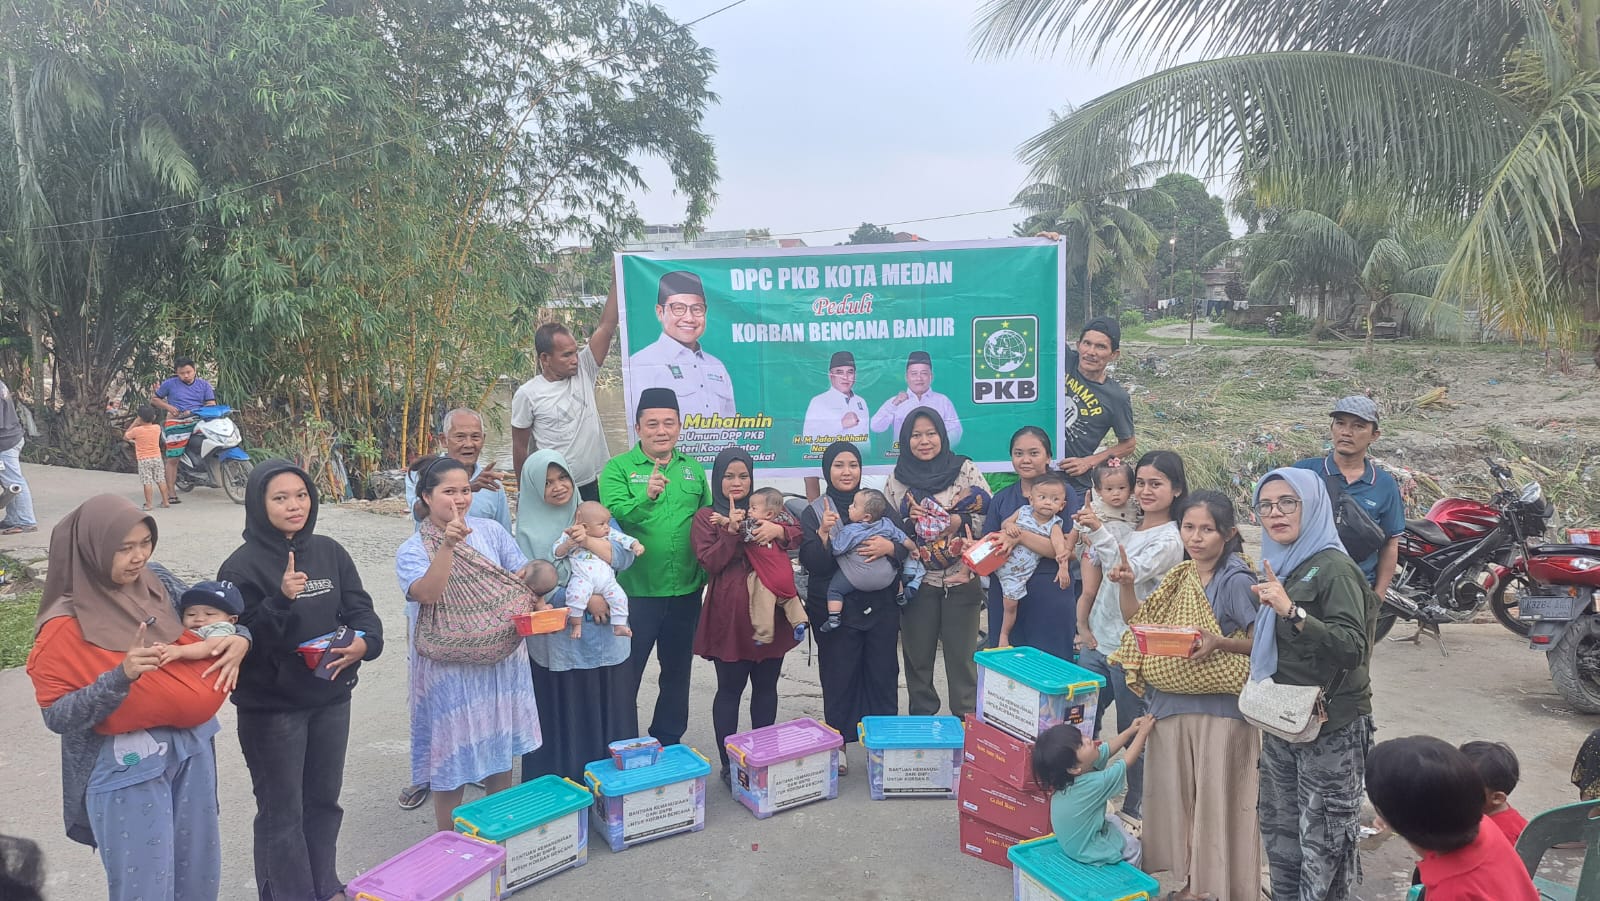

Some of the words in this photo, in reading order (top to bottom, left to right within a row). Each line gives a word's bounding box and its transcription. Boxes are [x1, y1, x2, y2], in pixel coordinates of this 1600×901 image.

[730, 268, 773, 291] DPC
[778, 266, 820, 290] PKB
[825, 264, 877, 288] KOTA
[881, 261, 953, 286] MEDAN
[812, 292, 874, 316] Peduli
[731, 322, 805, 343] KORBAN
[809, 319, 889, 342] BENCANA
[893, 317, 955, 339] BANJIR
[975, 381, 1036, 401] PKB
[684, 413, 773, 430] Muhaimin
[686, 431, 720, 441] Umum
[721, 431, 742, 440] DPP
[743, 430, 765, 440] PKB
